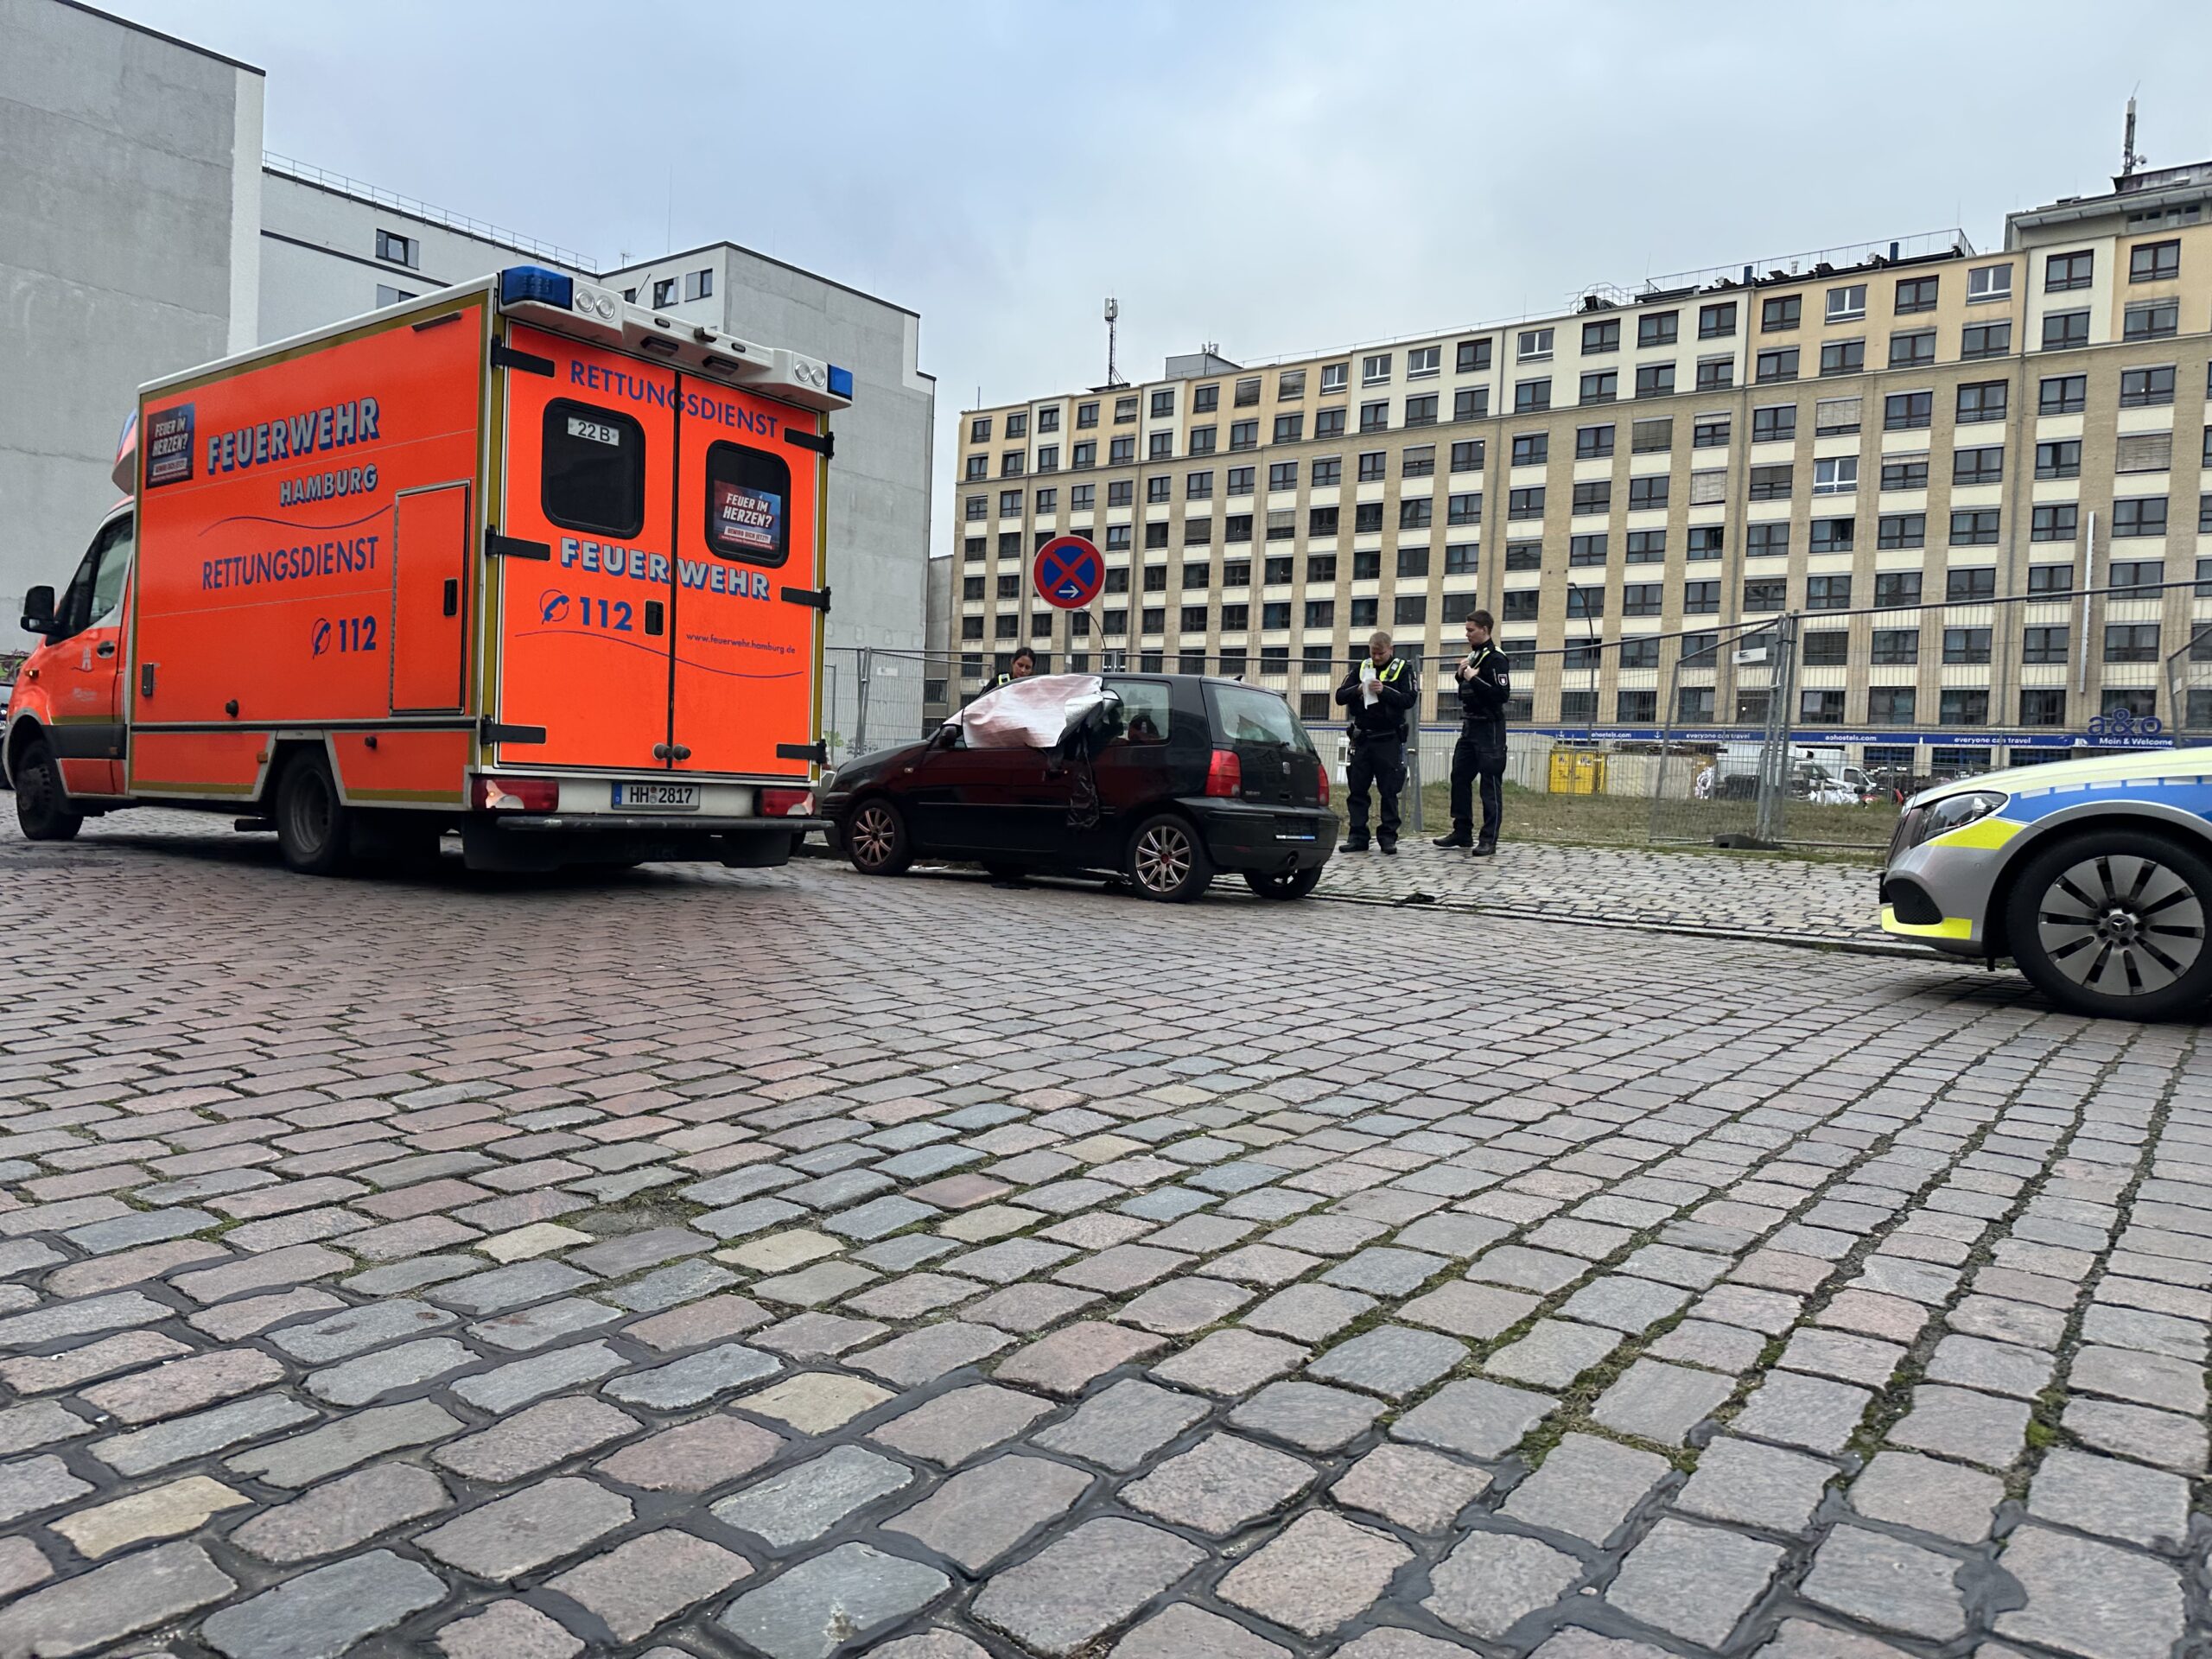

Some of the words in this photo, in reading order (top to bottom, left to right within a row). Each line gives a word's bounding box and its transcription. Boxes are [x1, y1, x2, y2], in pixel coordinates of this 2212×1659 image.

[570, 359, 779, 437] RETTUNGSDIENST
[156, 420, 175, 438] FEUER
[207, 397, 380, 475] FEUERWEHR
[578, 422, 596, 439] 22
[600, 426, 610, 442] B
[152, 433, 189, 457] HERZEN?
[280, 463, 378, 506] HAMBURG
[726, 493, 755, 510] FEUER
[757, 499, 768, 512] IM
[722, 505, 772, 528] HERZEN?
[202, 536, 378, 590] RETTUNGSDIENST
[579, 596, 633, 632] 112
[339, 615, 377, 652] 112
[686, 633, 796, 654] www.feuerwehr.hamburgde
[2088, 708, 2163, 736] a&o
[1824, 734, 1878, 742] aohostels.com
[2099, 737, 2121, 746] Moin
[2132, 738, 2174, 747] Welcome
[630, 786, 649, 803] HH
[658, 787, 693, 804] 2817
